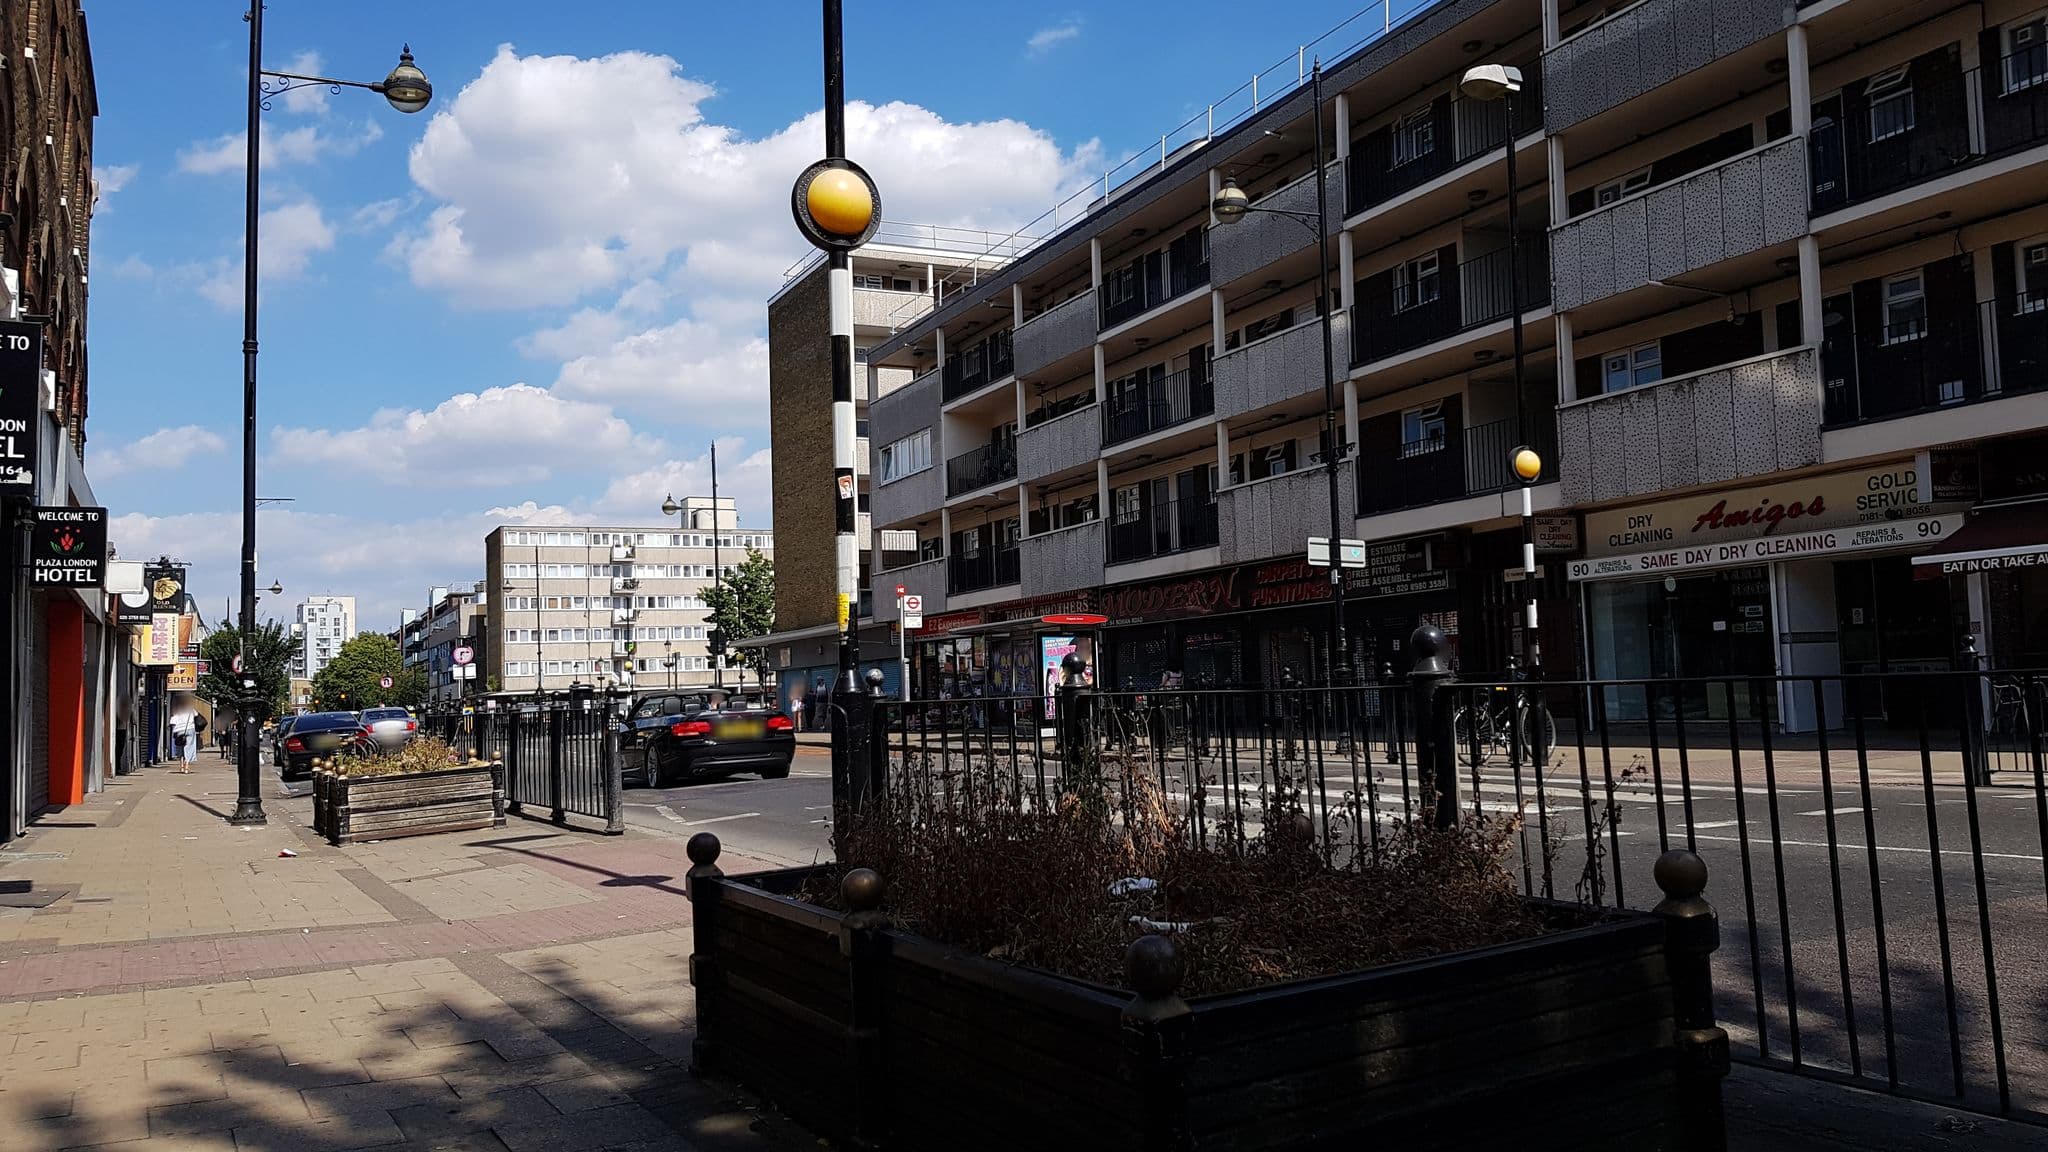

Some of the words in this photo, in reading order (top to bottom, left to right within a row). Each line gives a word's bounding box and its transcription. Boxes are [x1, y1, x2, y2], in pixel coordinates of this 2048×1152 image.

[7, 335, 30, 350] TO
[1867, 470, 1917, 492] GOLD
[38, 512, 84, 522] WELCOME
[86, 512, 99, 521] TO
[1628, 513, 1654, 530] DRY
[1691, 495, 1826, 537] Amigos
[1856, 528, 1888, 539] REPAIRS
[1890, 527, 1897, 535] &
[1917, 519, 1942, 537] 90
[1609, 527, 1673, 548] CLEANING
[1851, 533, 1904, 547] ALTERATIONS
[1371, 542, 1407, 556] ESTIMATE
[1640, 552, 1679, 570] SAME
[1685, 548, 1715, 565] DAY
[1720, 544, 1749, 561] DRY
[1755, 533, 1837, 556] CLEANING
[36, 558, 62, 567] PLAZA
[63, 558, 98, 567] LONDON
[1371, 553, 1407, 566] DELIVERY
[1943, 560, 1964, 573] EAT
[1967, 559, 1979, 571] IN
[1981, 558, 2000, 570] OR
[2003, 554, 2035, 568] TAKE
[35, 568, 98, 582] HOTEL
[1352, 569, 1370, 579] FREE
[1371, 564, 1401, 577] FITTING
[1572, 562, 1590, 577] 90
[1352, 579, 1371, 589] FREE
[1372, 572, 1412, 586] ASSEMBLE
[1101, 567, 1241, 617] MODERN
[1380, 585, 1395, 595] TEL:
[1040, 599, 1090, 616] BROTHERS
[167, 676, 195, 684] EDEN
